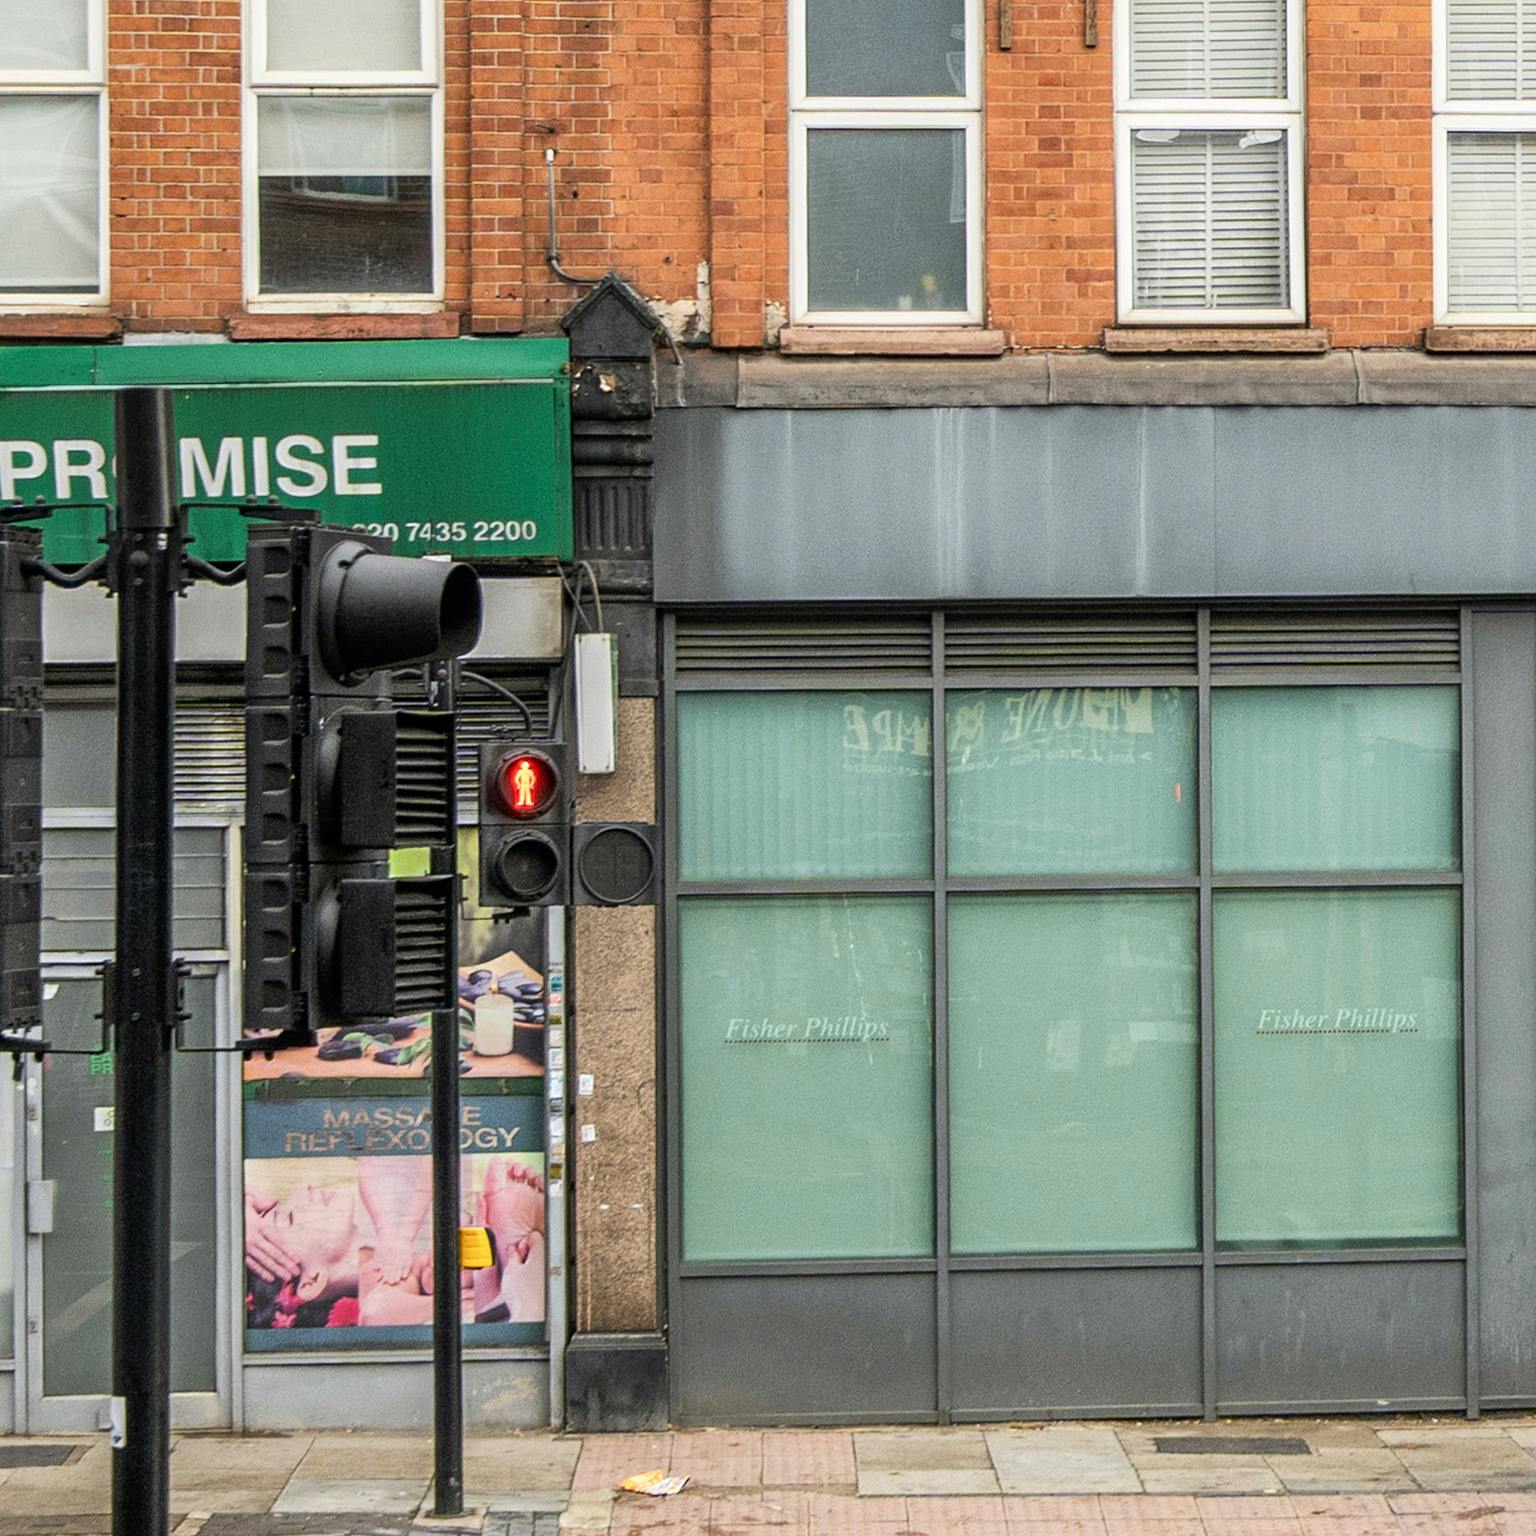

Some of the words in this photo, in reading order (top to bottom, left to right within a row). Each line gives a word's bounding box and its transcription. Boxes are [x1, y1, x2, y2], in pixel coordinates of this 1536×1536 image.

[0, 434, 383, 500] PRMISE
[405, 521, 468, 542] 7435
[473, 520, 537, 542] 2200
[724, 1017, 799, 1039] Fisher
[803, 1016, 889, 1042] Phillips
[1258, 1008, 1329, 1029] Fisher
[1334, 1007, 1418, 1033] Phillips
[323, 1106, 482, 1128] MASSAE
[284, 1126, 521, 1153] REFLEXOOGY
